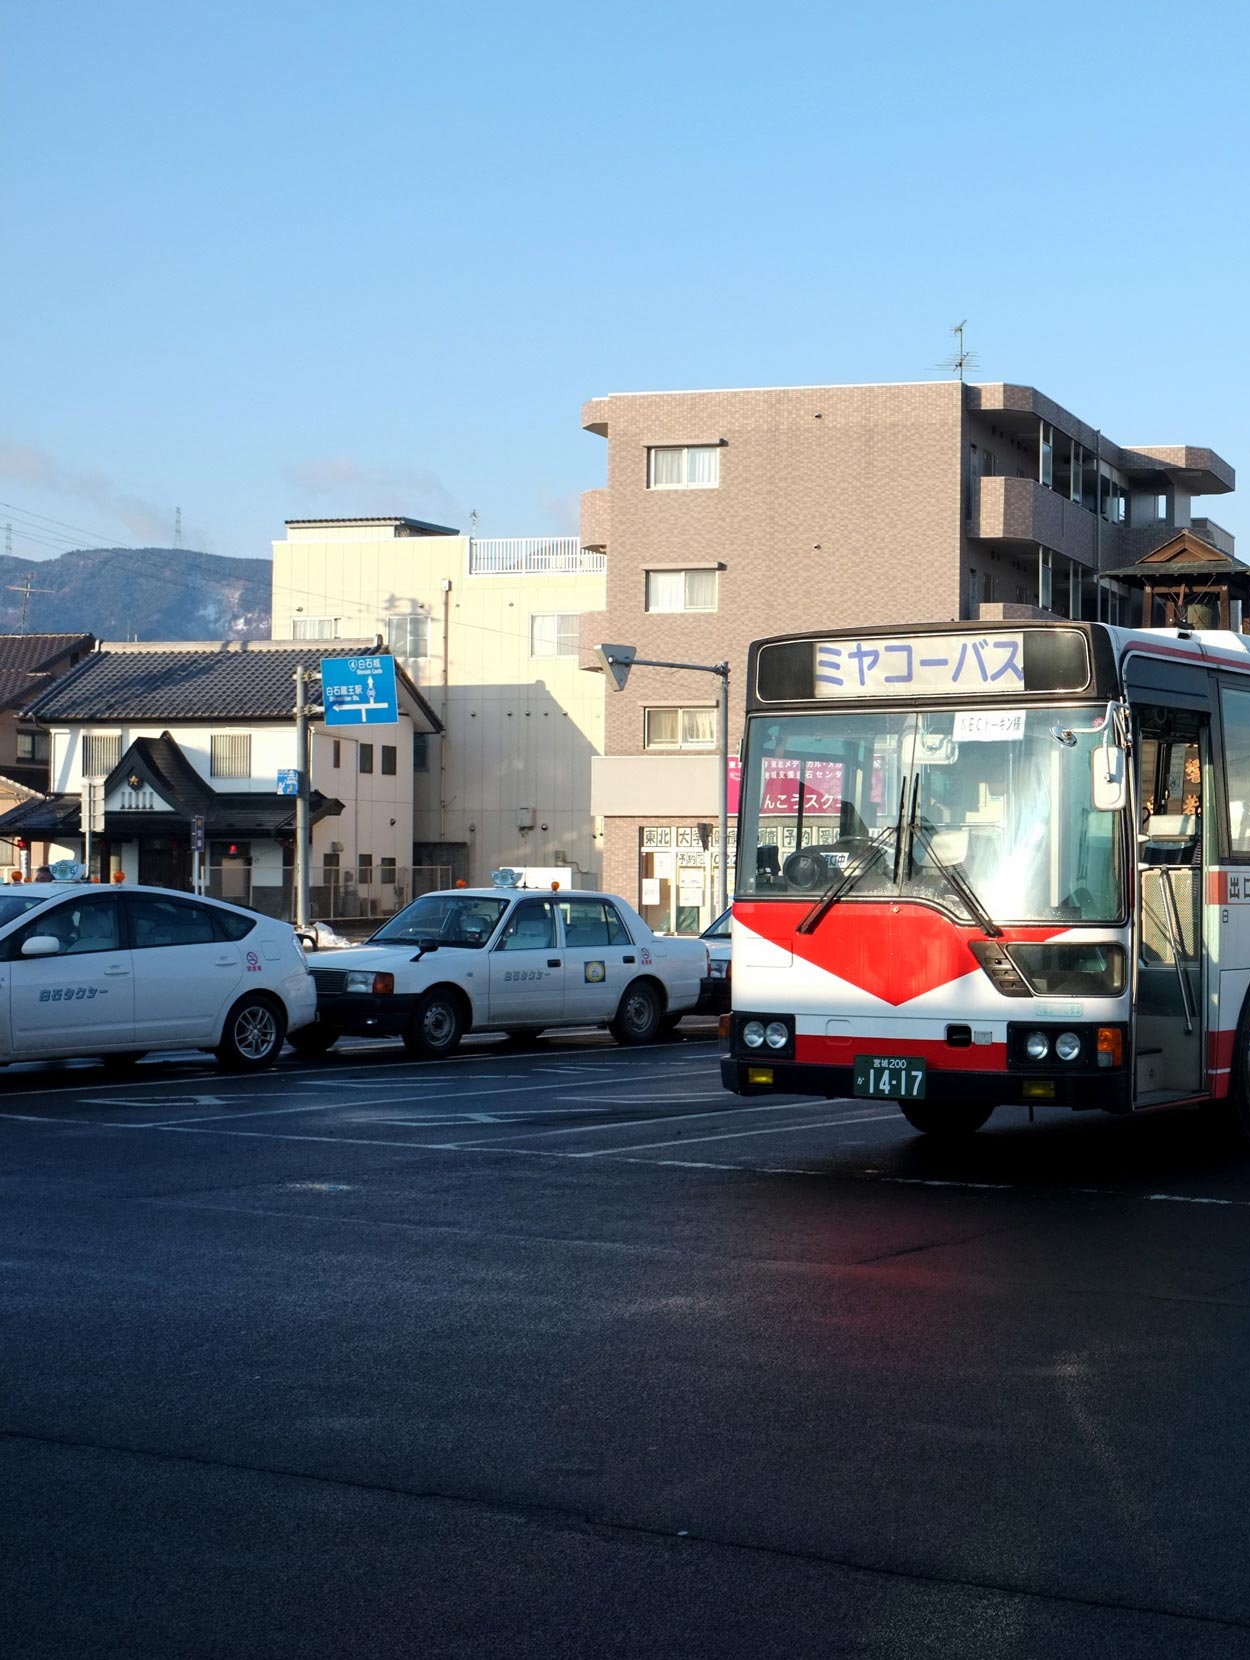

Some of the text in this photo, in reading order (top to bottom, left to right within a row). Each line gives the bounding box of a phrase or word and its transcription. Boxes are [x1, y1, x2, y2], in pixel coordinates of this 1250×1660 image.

[815, 638, 1024, 686] ミヤコーバス
[39, 987, 108, 1002] 白石タクシー
[869, 1069, 923, 1096] 14-17
